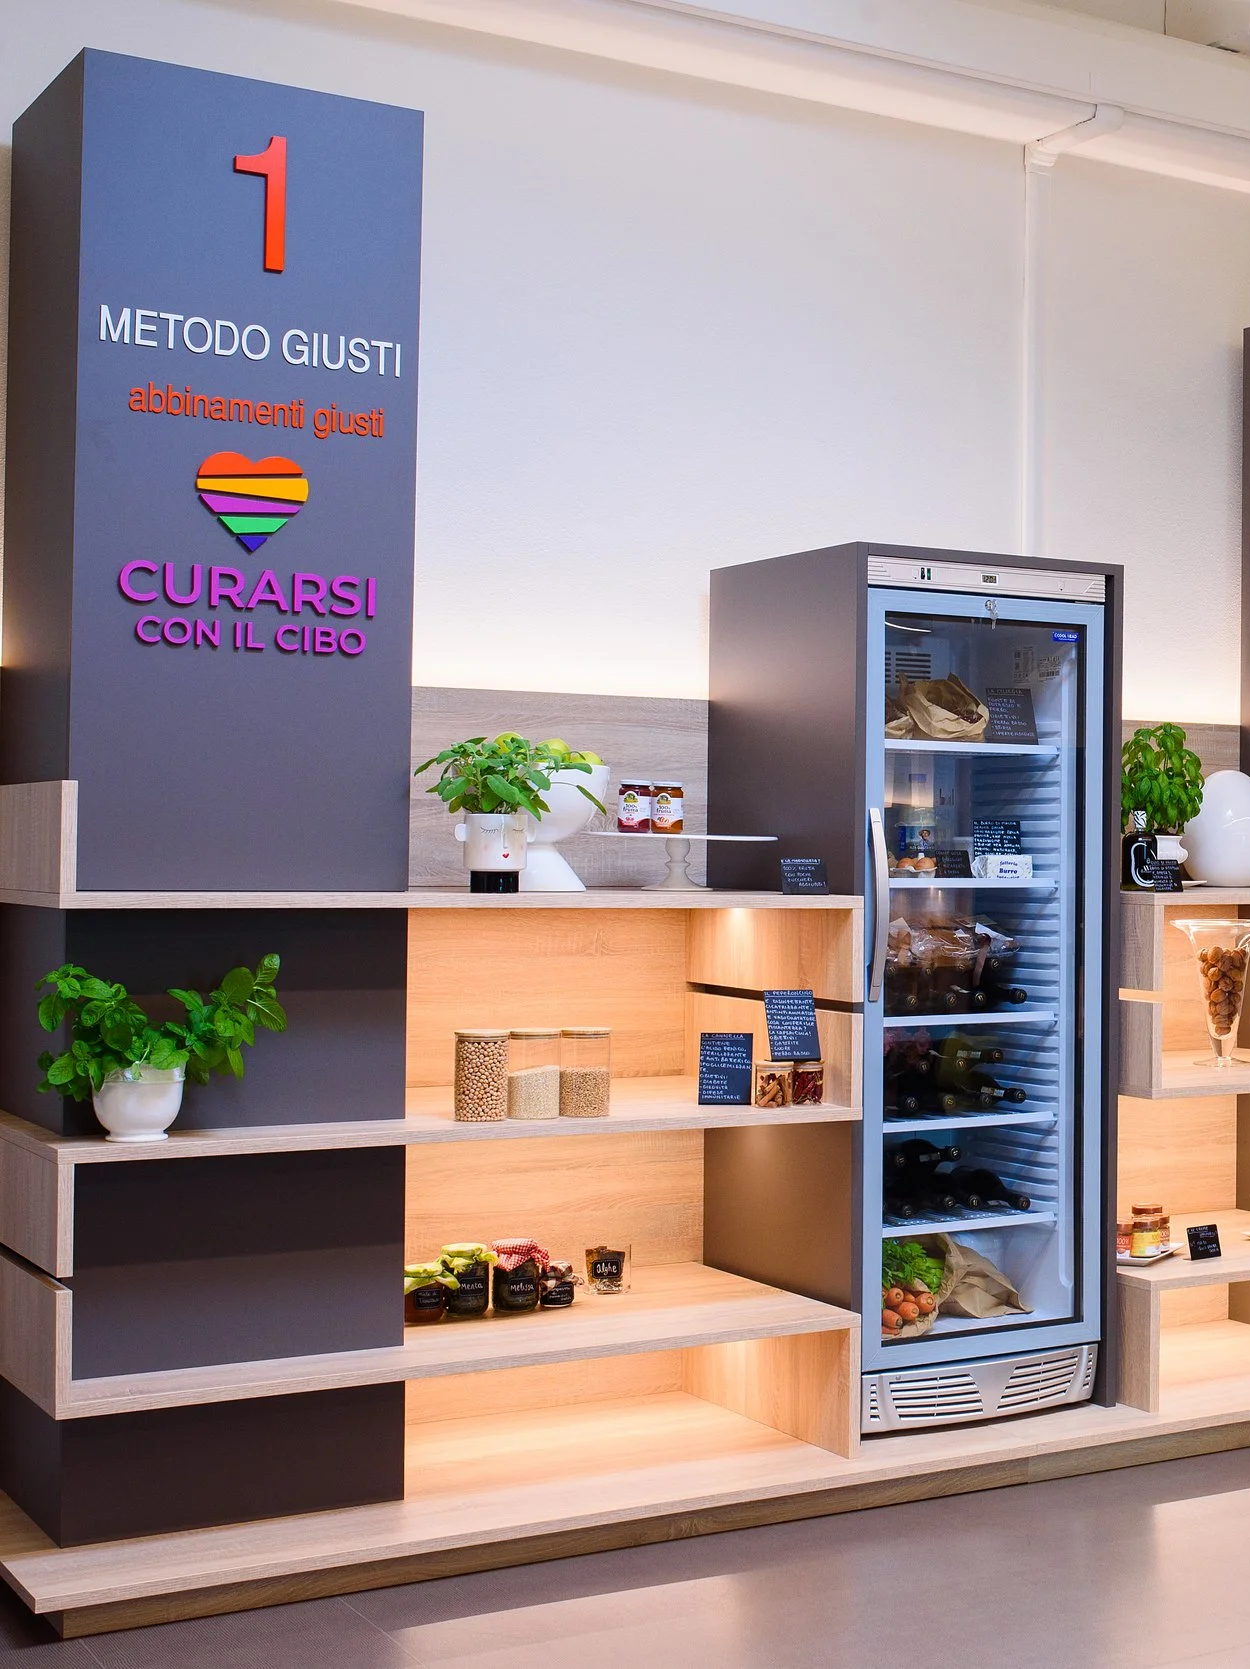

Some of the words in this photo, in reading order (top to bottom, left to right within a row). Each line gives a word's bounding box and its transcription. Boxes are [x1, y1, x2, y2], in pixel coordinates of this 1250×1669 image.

[234, 135, 287, 273] 1
[100, 304, 271, 361] METODO
[282, 329, 402, 378] GIUSTI
[128, 381, 304, 430] abbinamenti
[313, 402, 385, 439] giusti
[117, 559, 378, 619] CURARSI
[135, 615, 221, 648] CON
[234, 621, 264, 651] IL
[276, 624, 366, 656] CIBO
[460, 1282, 484, 1290] Menta
[510, 1282, 535, 1292] Melissa
